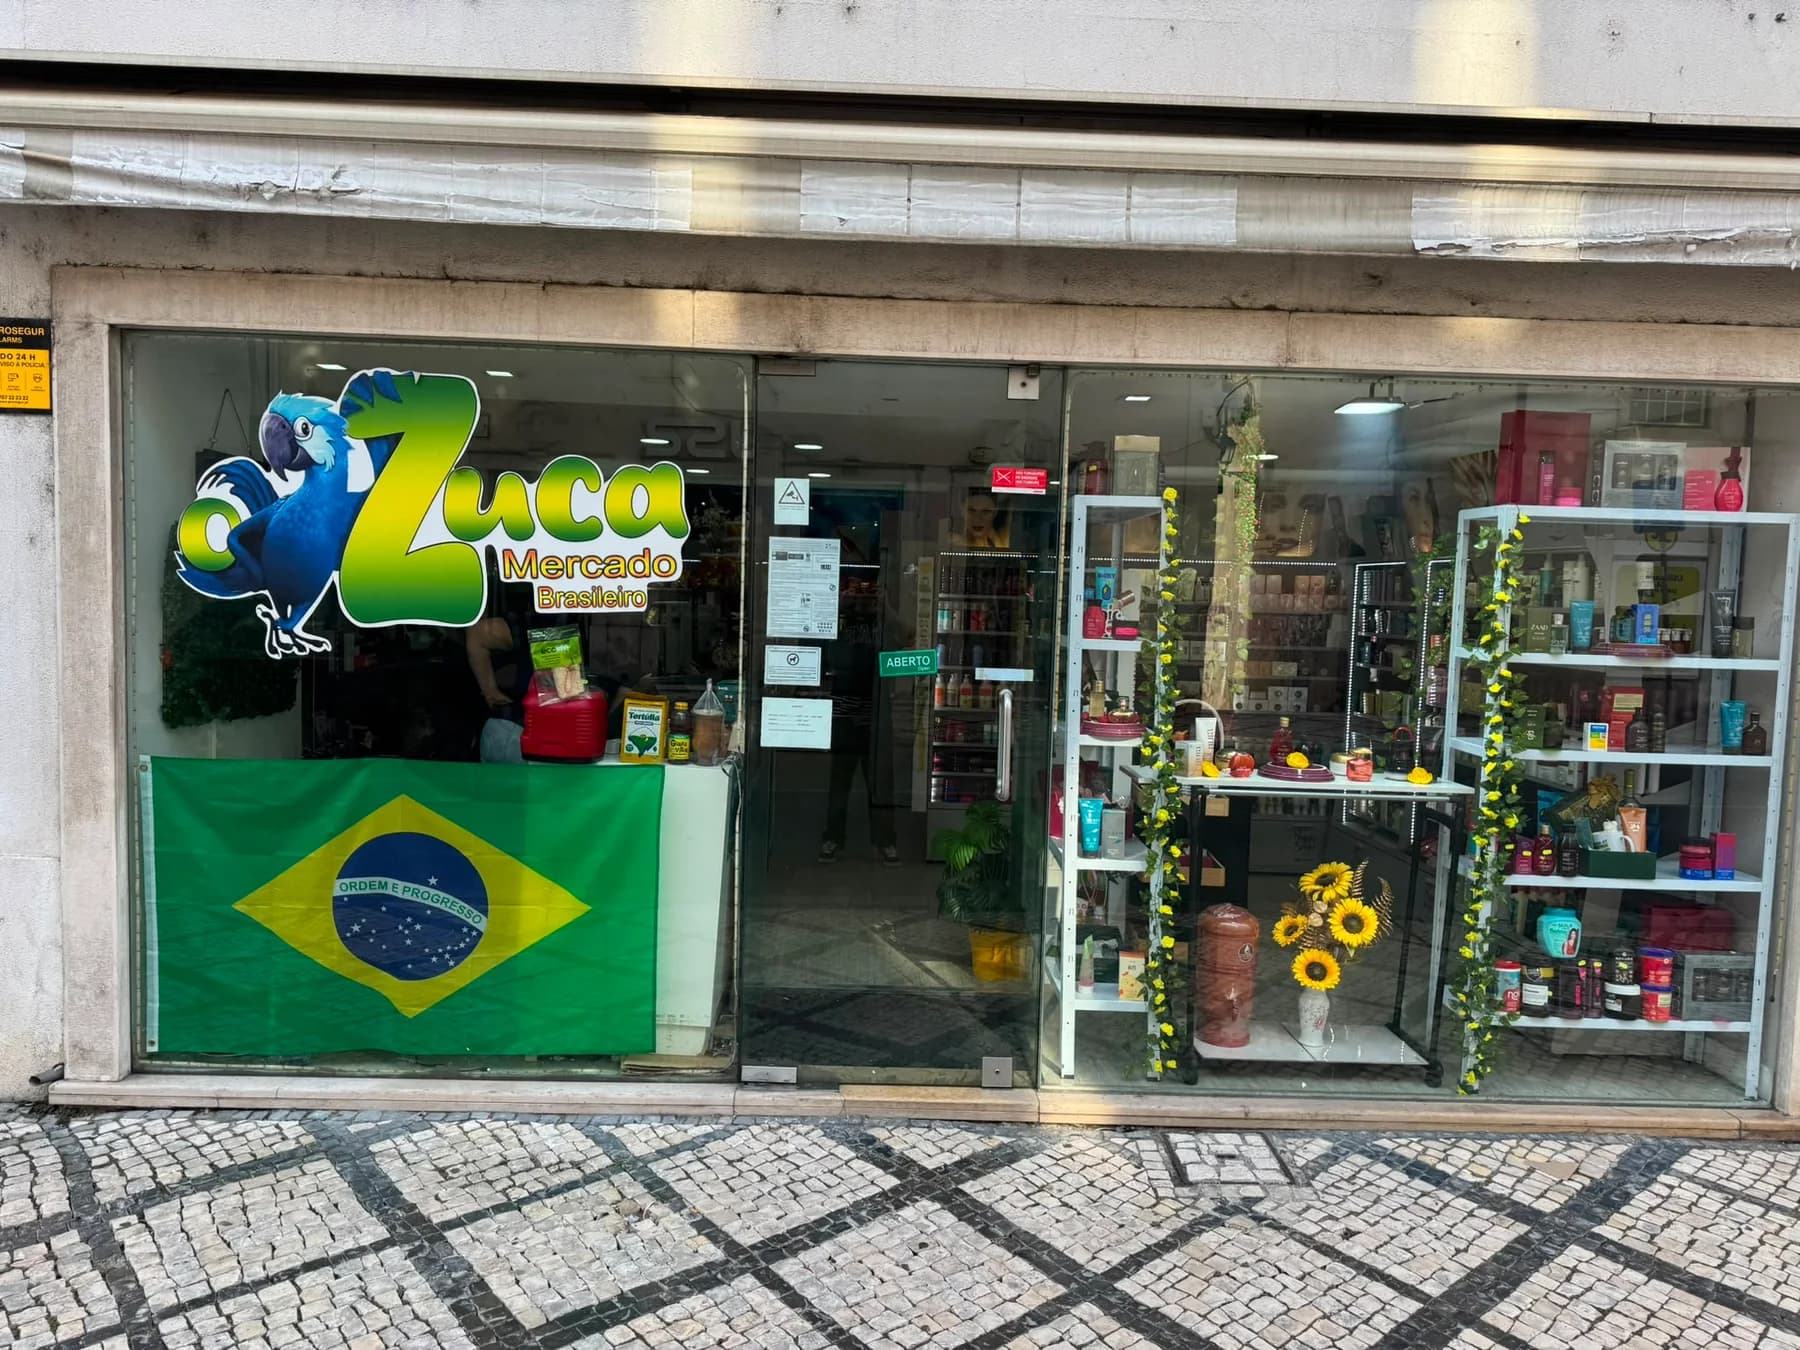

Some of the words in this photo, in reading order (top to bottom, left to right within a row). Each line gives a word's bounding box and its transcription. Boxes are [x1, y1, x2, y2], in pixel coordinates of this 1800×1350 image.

[0, 336, 23, 344] ARMS
[29, 353, 36, 361] H
[502, 548, 677, 580] Mercado
[537, 585, 647, 609] Brasileiro
[886, 655, 930, 668] ABERTO
[339, 880, 388, 892] ORDEM
[391, 883, 399, 893] E
[402, 886, 483, 925] PROGRESSO
